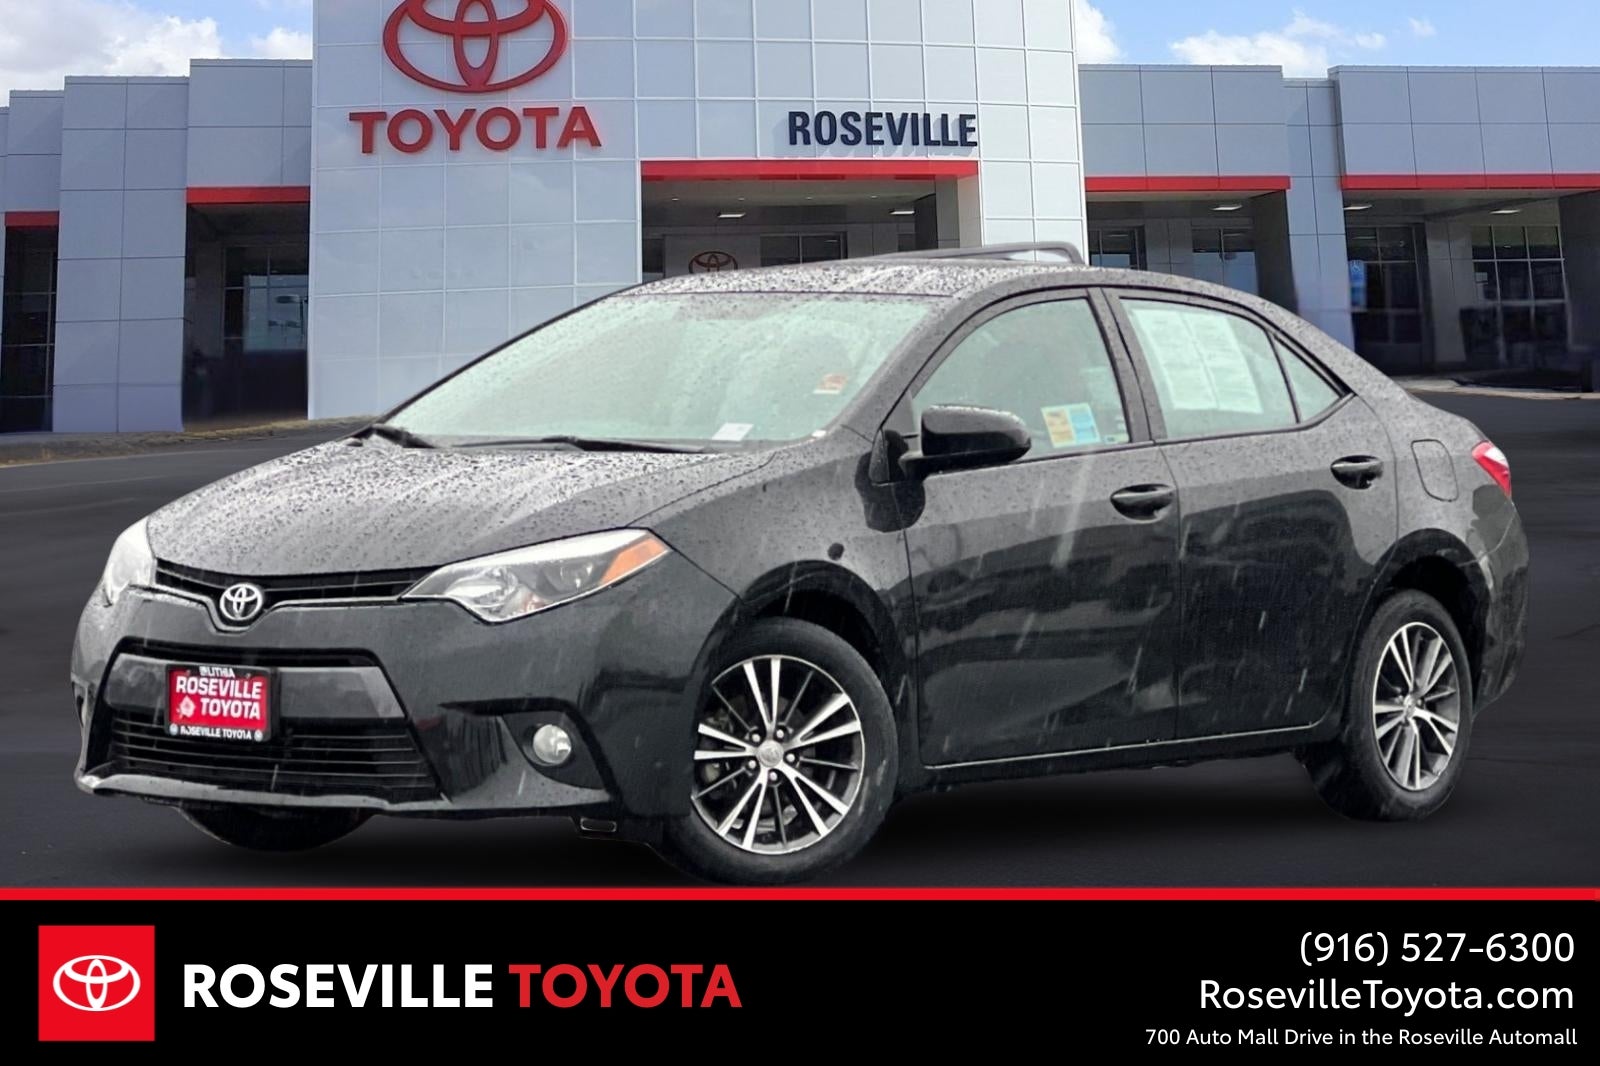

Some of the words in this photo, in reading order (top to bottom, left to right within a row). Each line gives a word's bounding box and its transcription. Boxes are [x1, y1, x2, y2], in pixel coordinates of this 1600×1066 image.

[349, 106, 602, 154] TOYOTA
[787, 111, 978, 147] ROSEVILLE
[207, 667, 235, 678] LITHIA
[176, 676, 263, 699] ROSEVILLE
[200, 698, 260, 719] TOYOTA
[180, 725, 221, 738] ROSEVILLE
[222, 728, 252, 740] TOYOTA
